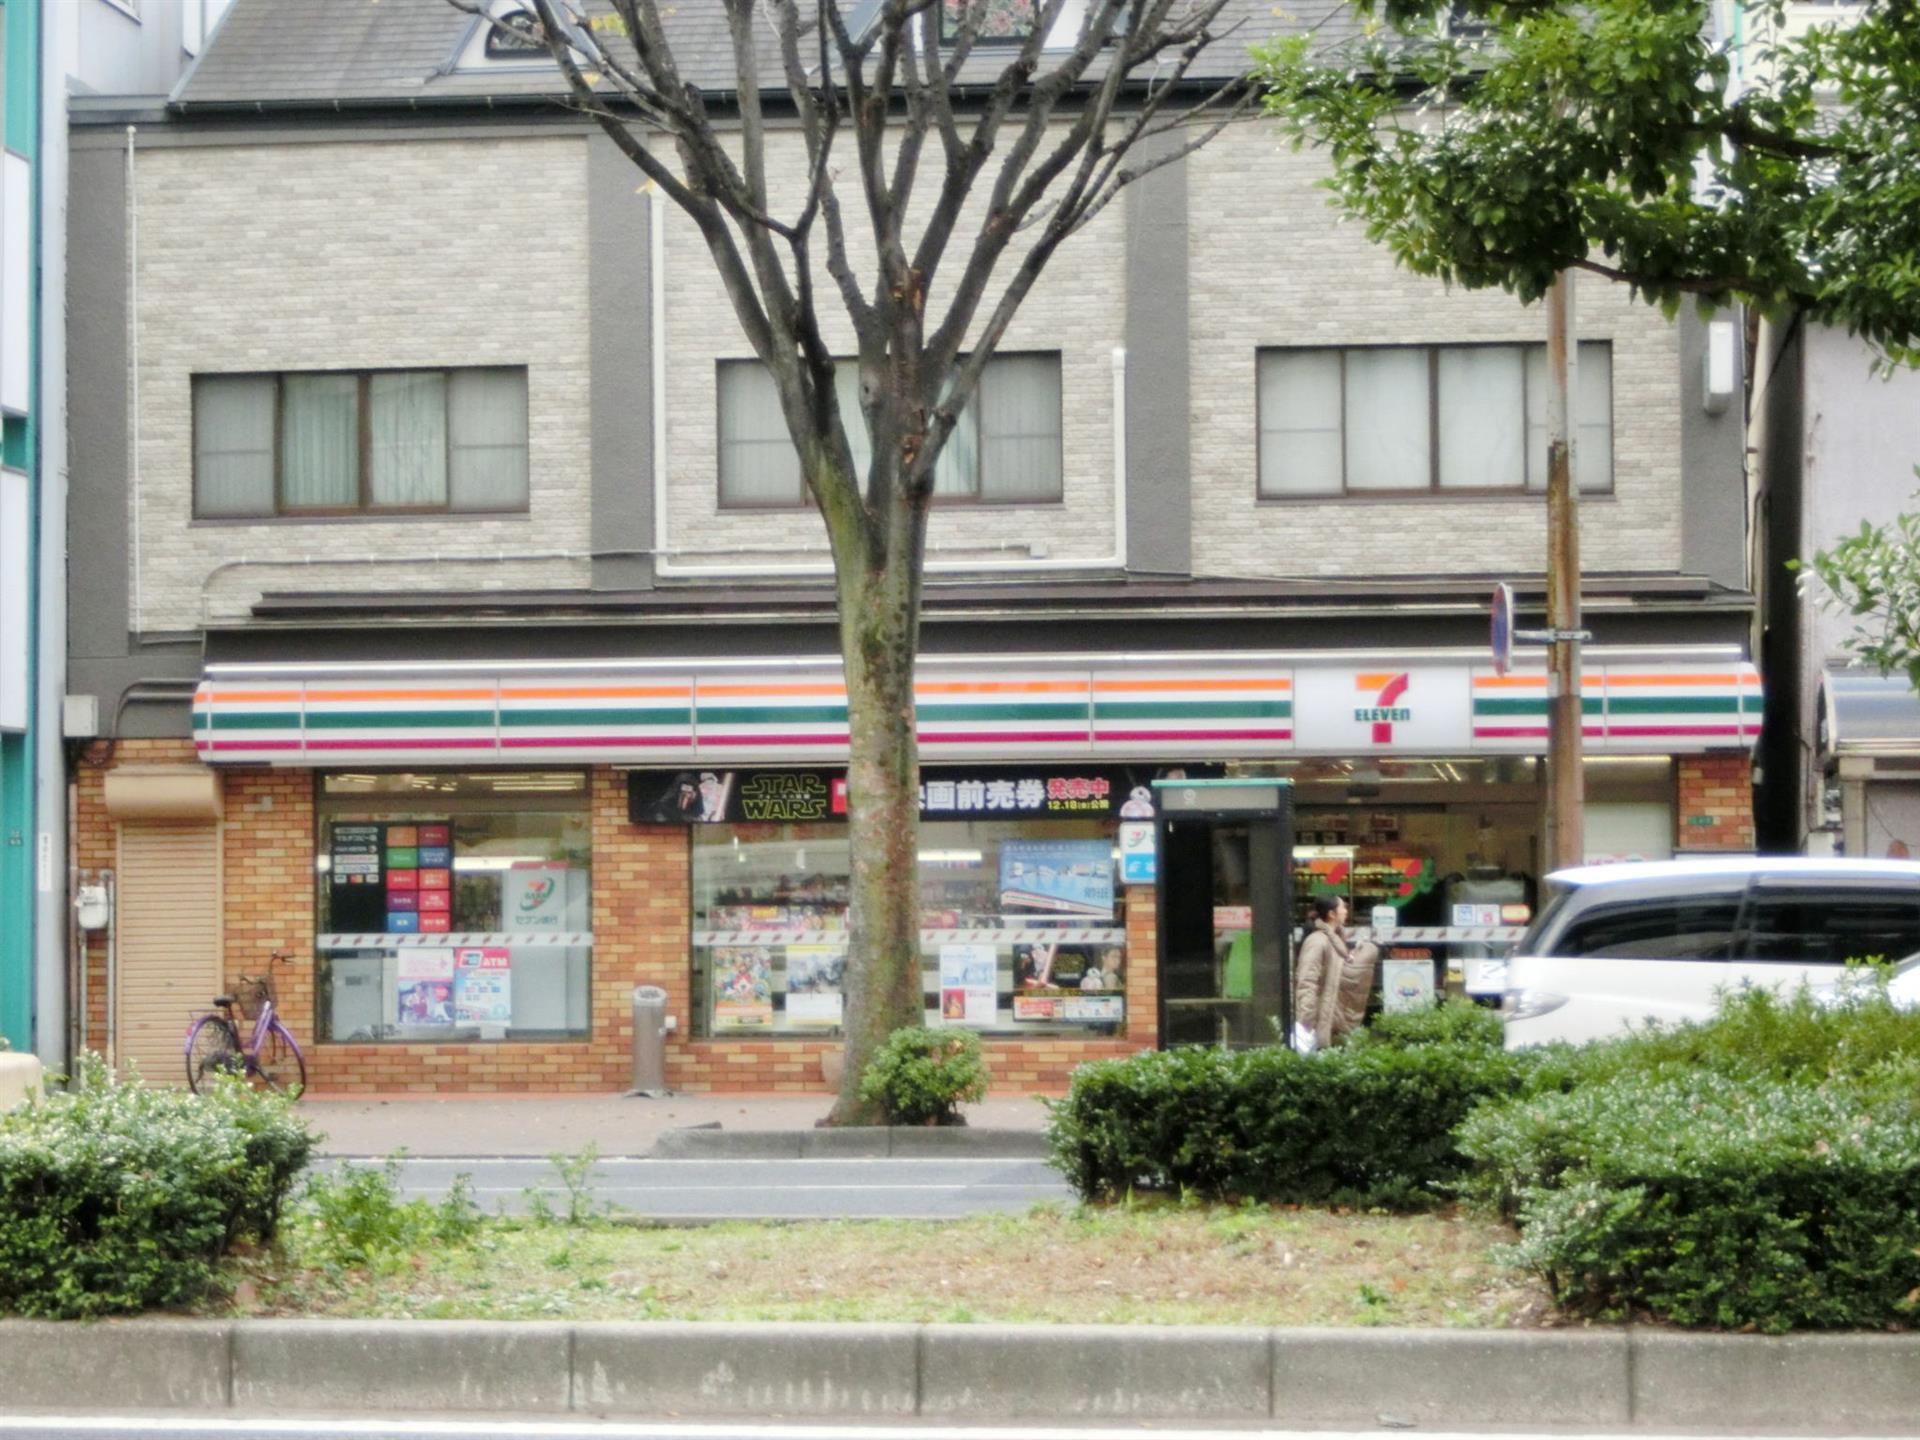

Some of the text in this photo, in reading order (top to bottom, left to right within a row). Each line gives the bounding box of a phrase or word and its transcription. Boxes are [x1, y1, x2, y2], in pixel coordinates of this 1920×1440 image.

[741, 774, 826, 794] STAR
[1047, 777, 1110, 799] 発売中
[919, 779, 1045, 811] 画前売券
[742, 799, 826, 819] WARS
